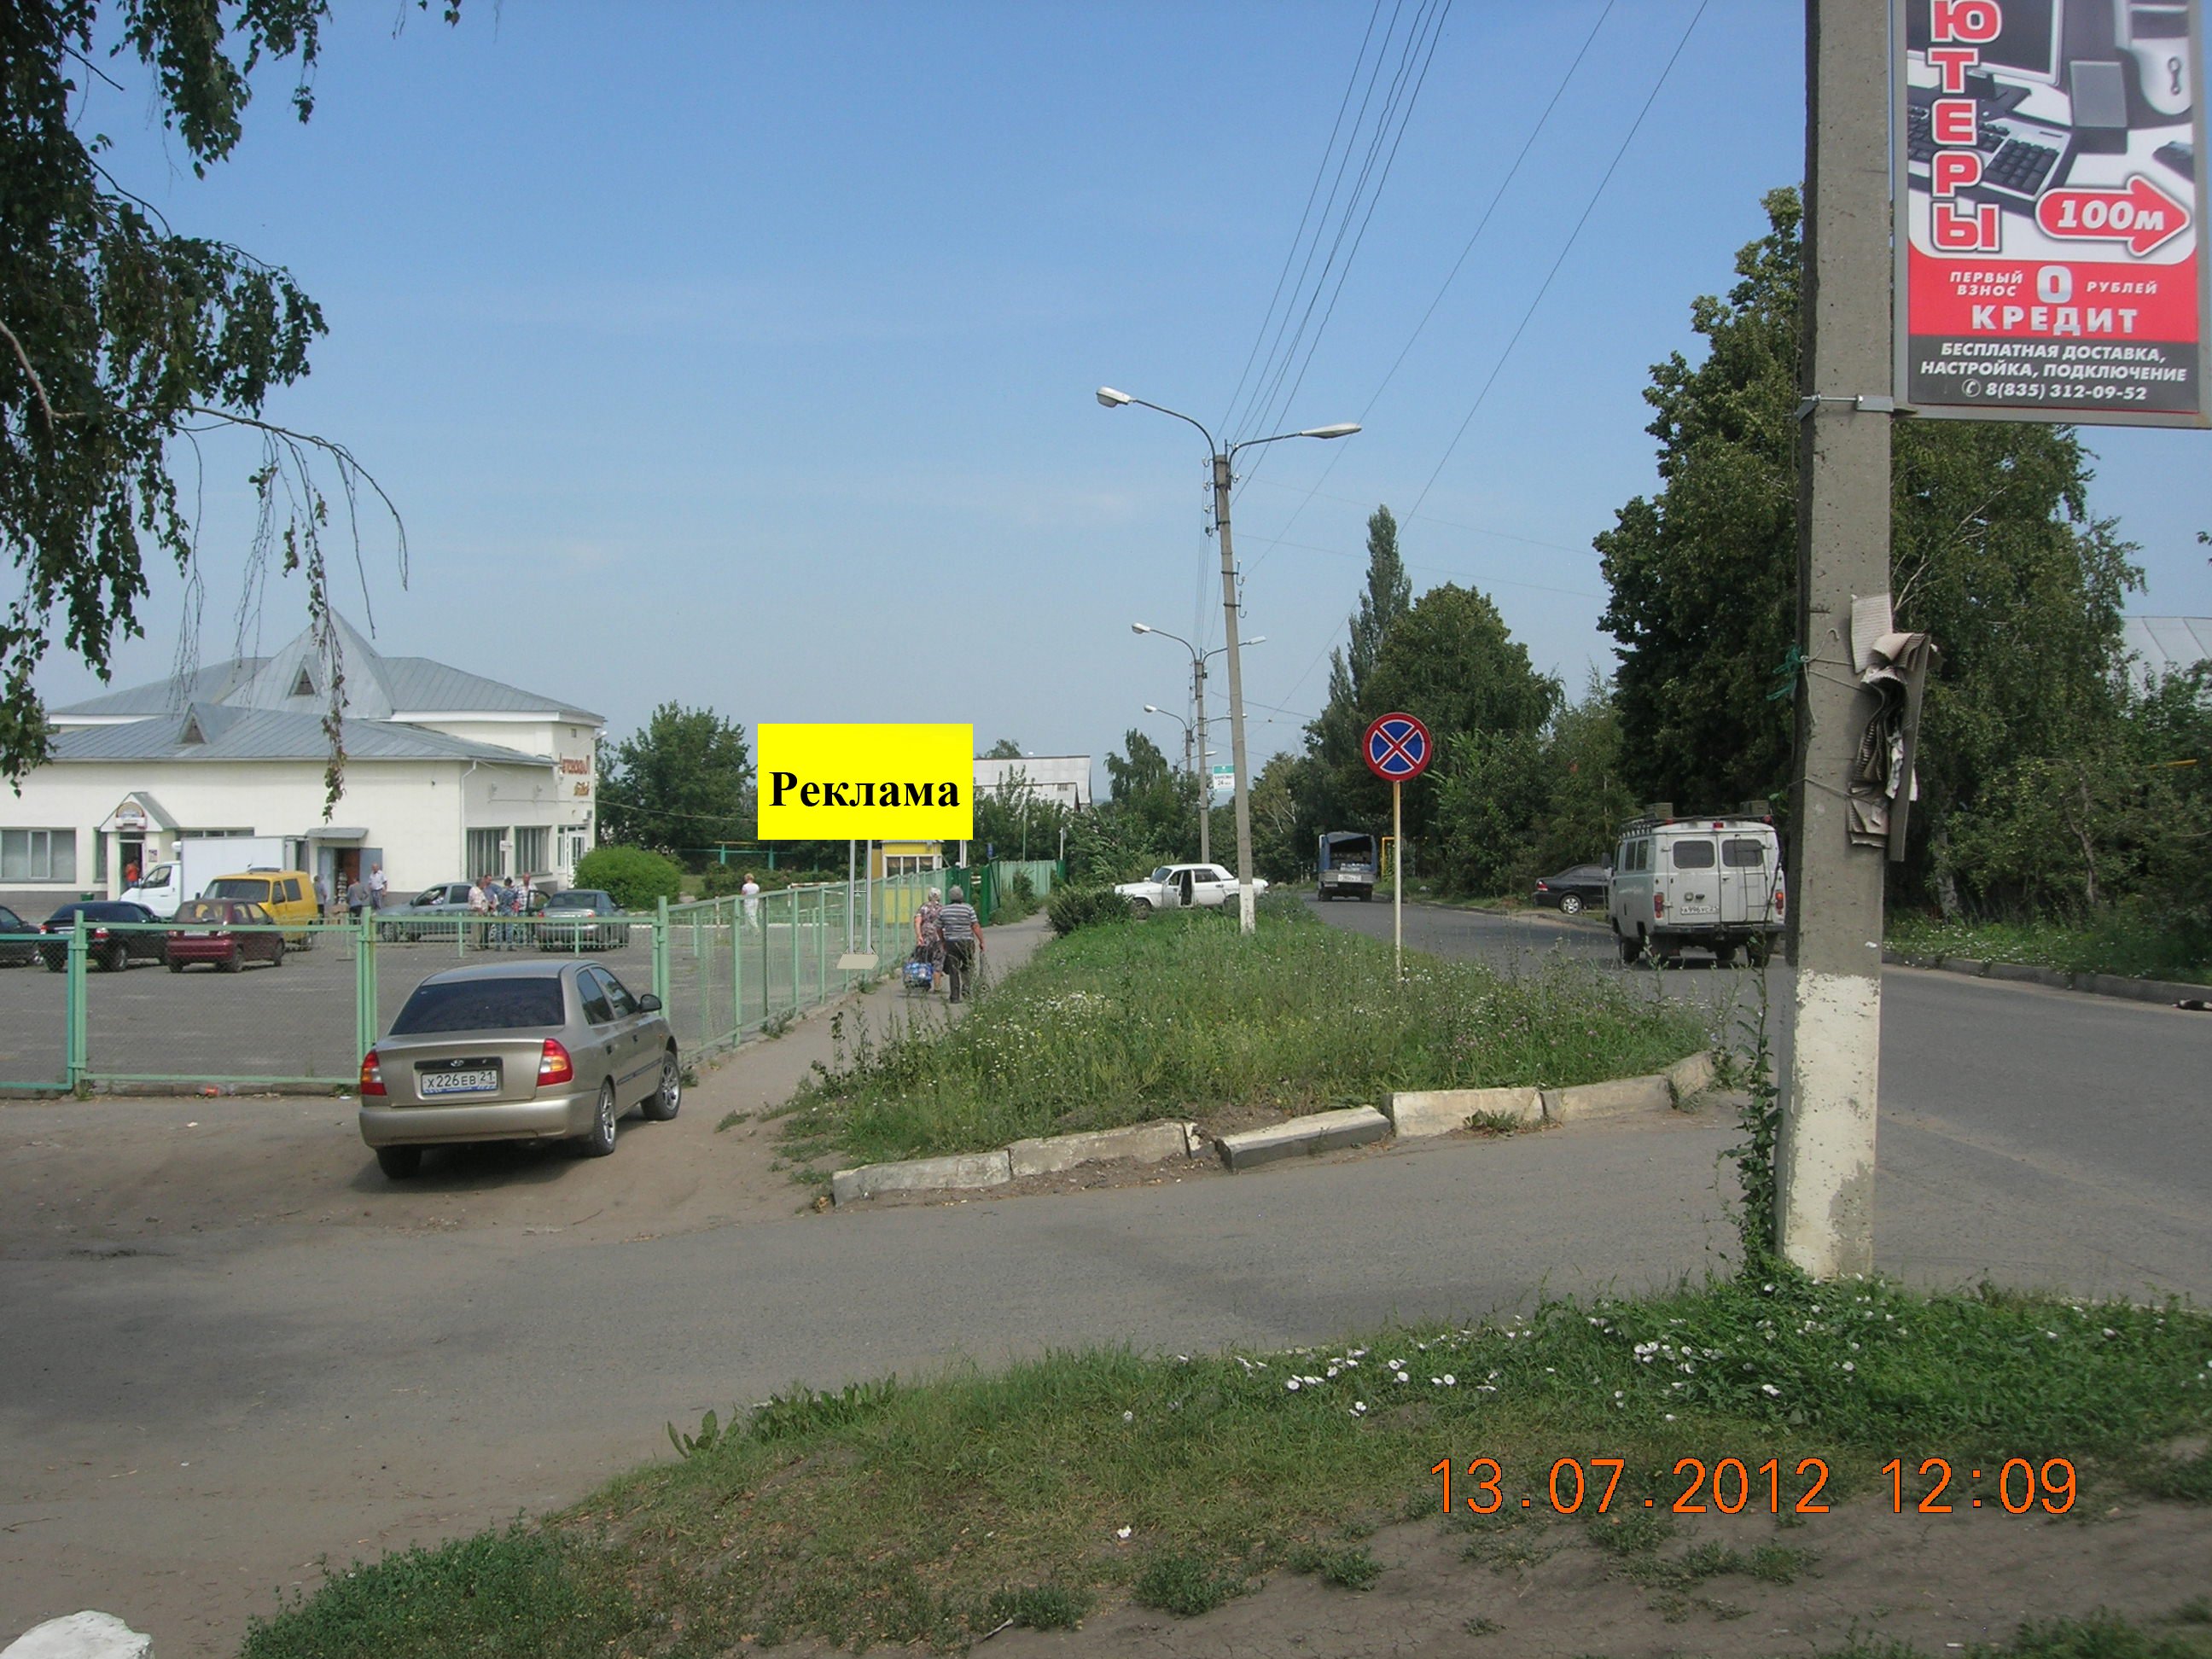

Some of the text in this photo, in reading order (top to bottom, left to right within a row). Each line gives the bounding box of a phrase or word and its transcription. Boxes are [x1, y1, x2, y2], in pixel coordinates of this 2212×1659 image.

[1950, 271, 2023, 283] ПЕРВЫЙ
[2037, 265, 2072, 304] 0
[1957, 284, 2017, 297] ВЗНОС
[2087, 281, 2158, 294] РУБЛЕЙ
[1972, 305, 2138, 336] КРЕДИТ
[1941, 342, 2167, 364] БЕСПЛАТНАЯ ДОСТАВКА,
[1921, 359, 2187, 381] НАСТРОЙКА, ПОДКЛЮЧЕНИЕ
[1985, 382, 2147, 401] 8(835) 312-09-52
